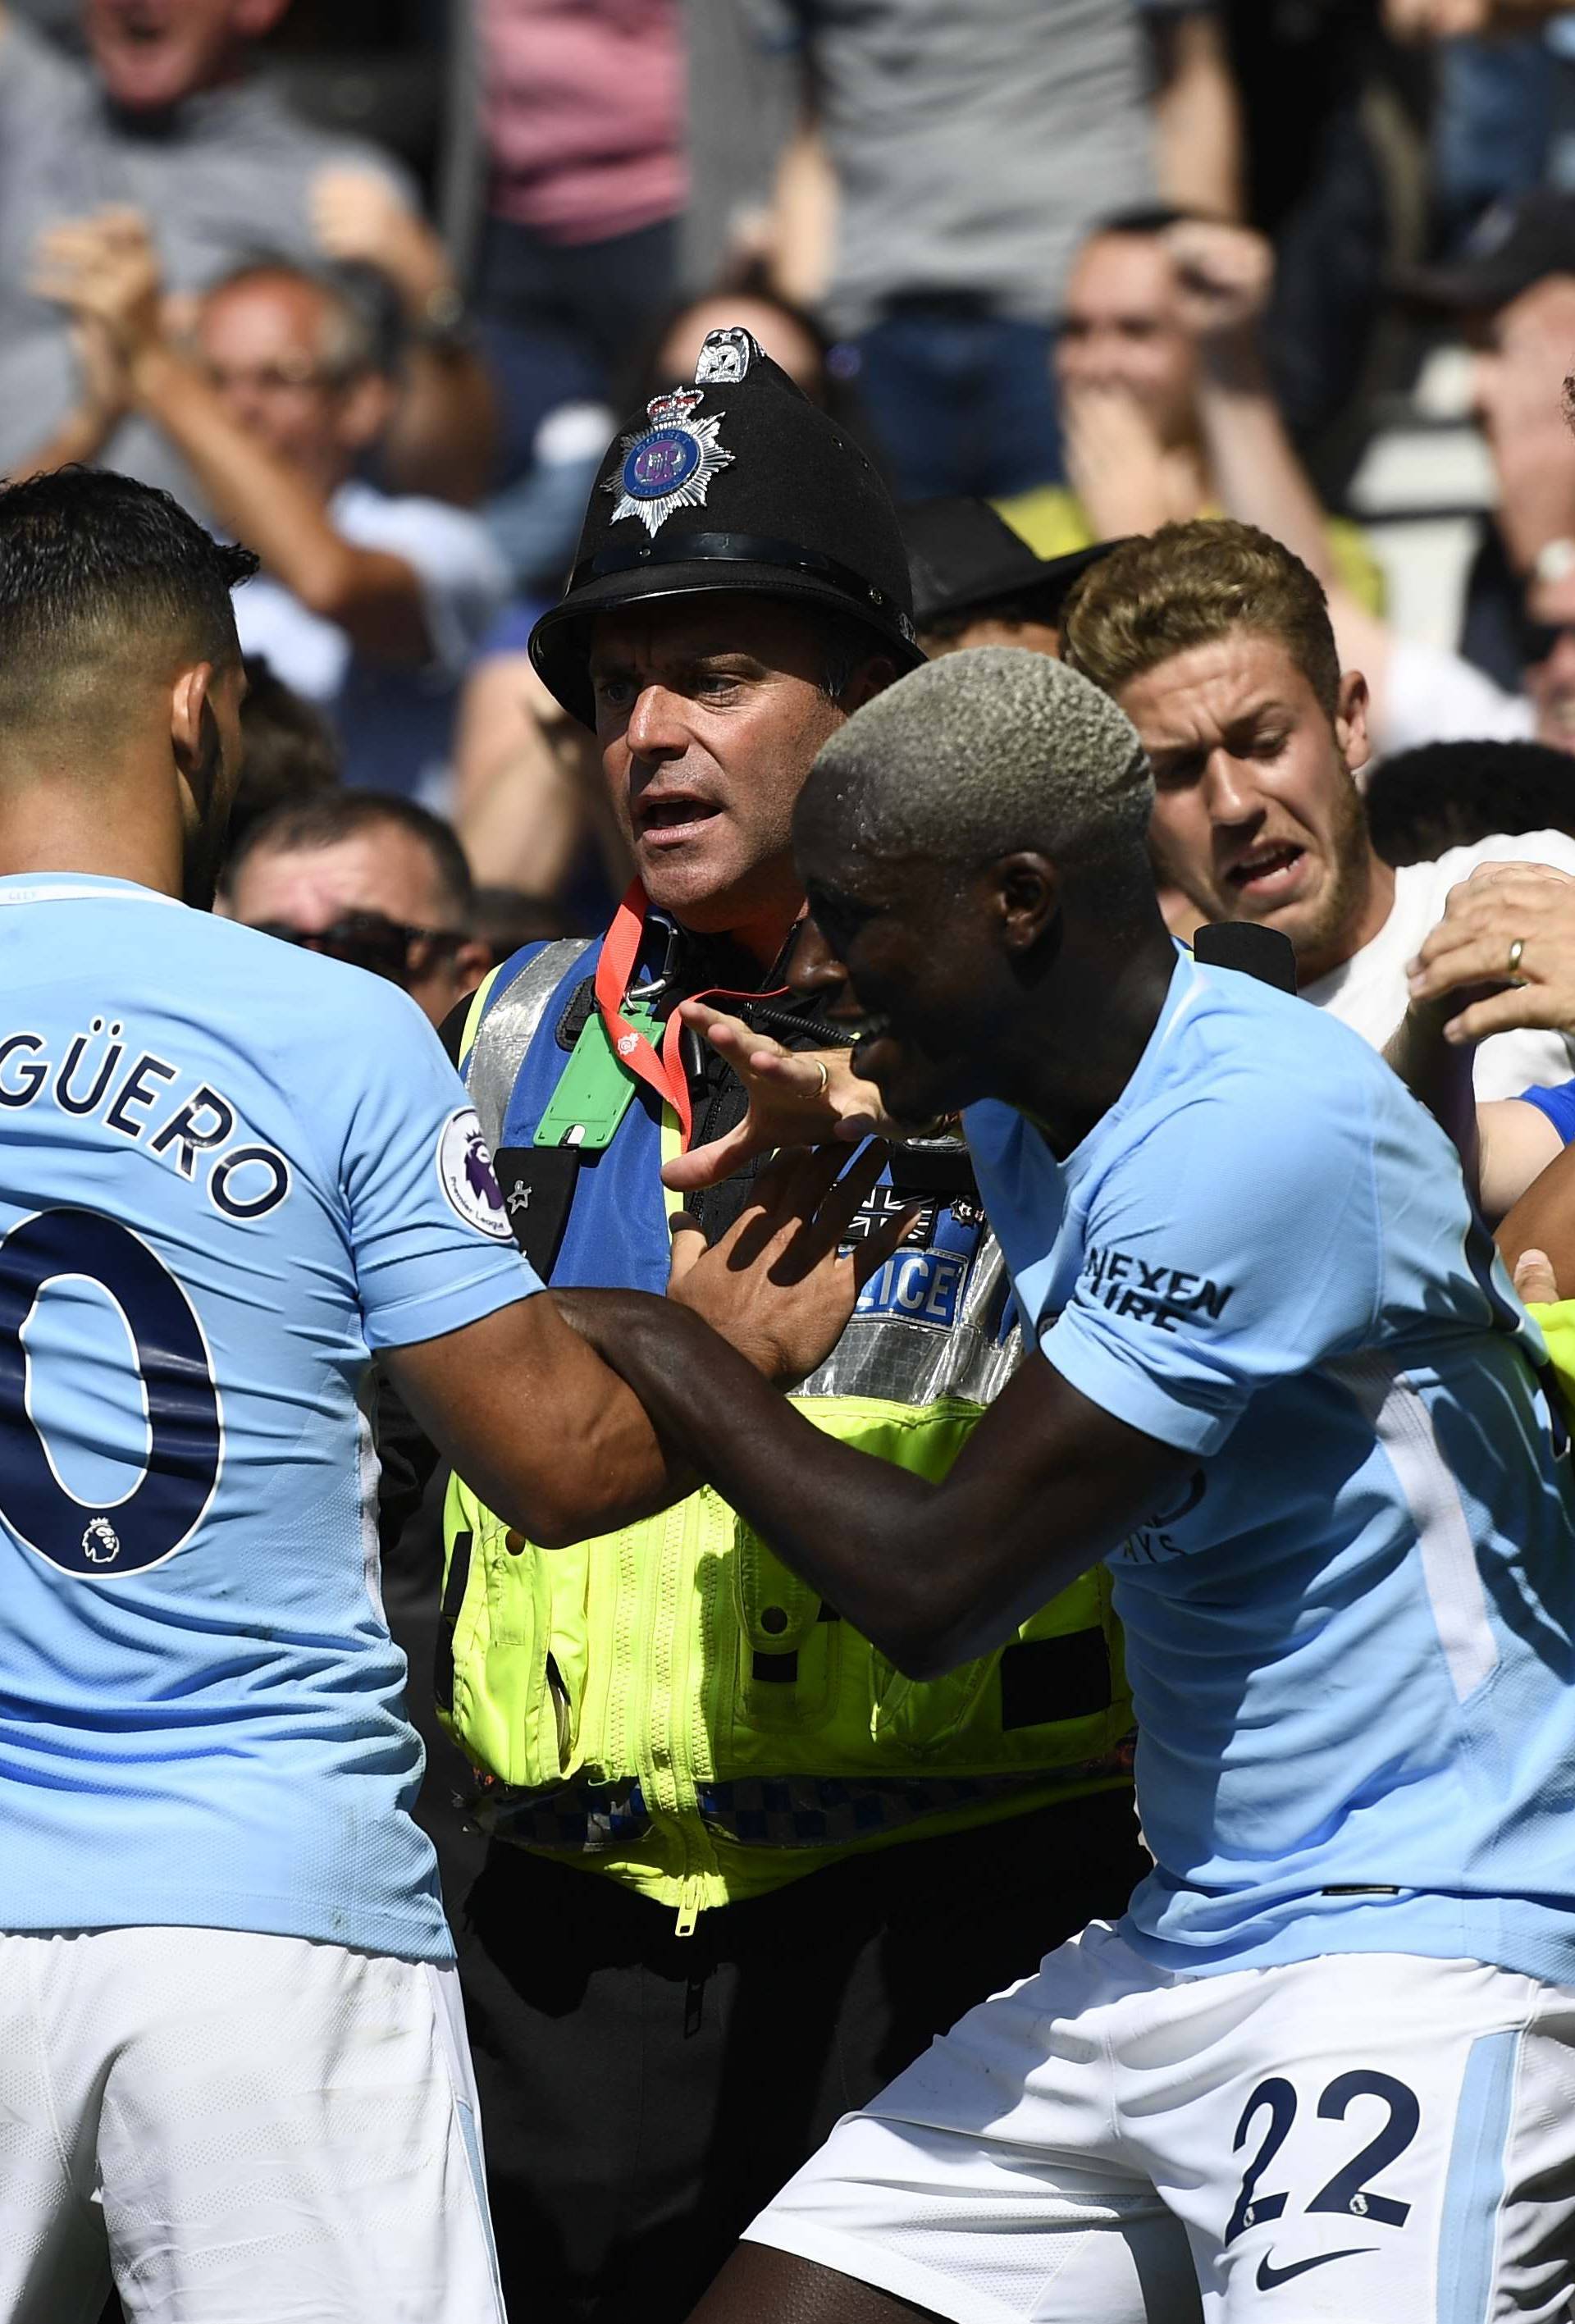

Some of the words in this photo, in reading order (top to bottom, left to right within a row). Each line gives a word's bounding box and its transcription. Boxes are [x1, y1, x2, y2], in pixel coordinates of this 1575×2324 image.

[0, 1015, 290, 1219] GÜERO
[1085, 1247, 1235, 1319] NEXEN
[1225, 2069, 1421, 2249] 22
